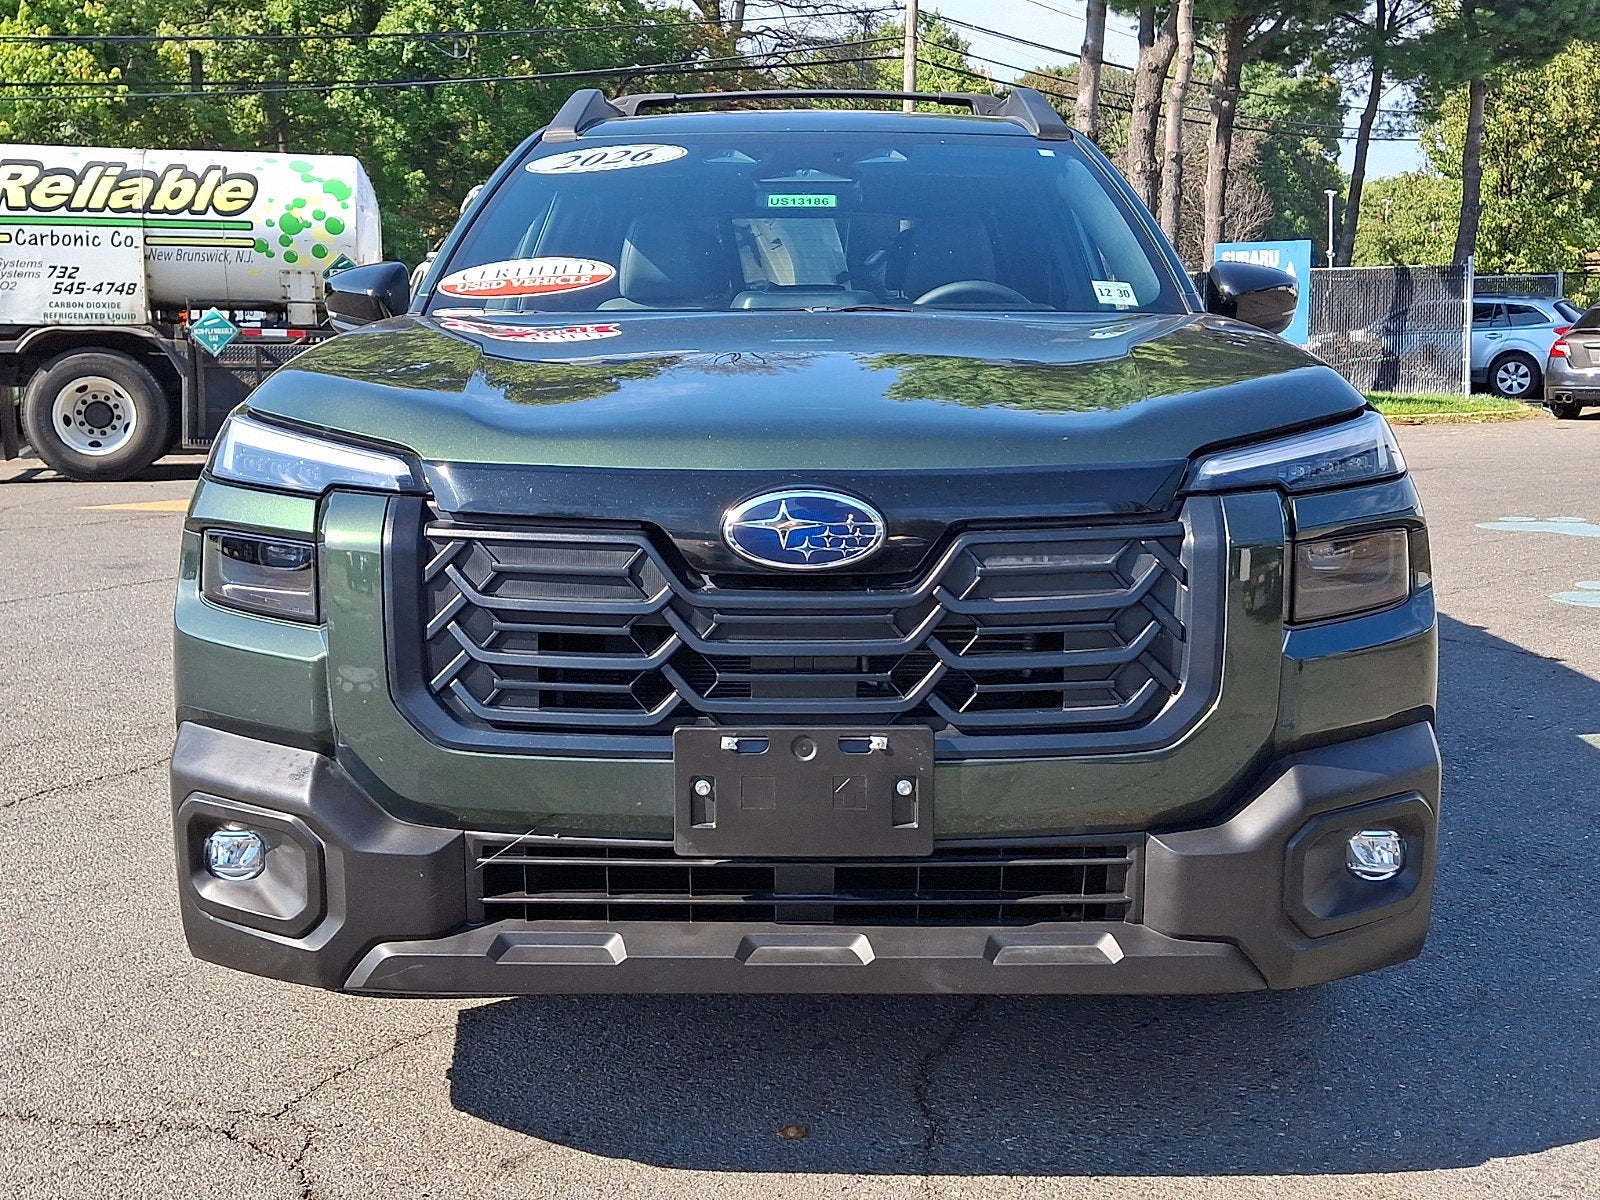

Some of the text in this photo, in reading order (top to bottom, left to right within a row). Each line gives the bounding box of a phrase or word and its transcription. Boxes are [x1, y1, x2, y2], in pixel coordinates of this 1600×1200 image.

[550, 147, 662, 170] 2026
[0, 159, 258, 216] Reliable
[770, 197, 829, 206] US13186
[15, 228, 140, 249] Carbonic Co.
[149, 248, 254, 265] New Brunswick, N.J.
[1221, 249, 1280, 268] SUBARU
[0, 267, 41, 279] ystems
[47, 265, 80, 279] 732
[0, 280, 17, 291] O2
[52, 281, 138, 295] 545-4748
[455, 275, 593, 292] USED VEHICLE
[1098, 287, 1130, 298] 12 30
[48, 301, 121, 310] CARBON DIOXIDE
[43, 311, 136, 320] REFRIGERATED LIQUID
[208, 334, 219, 342] GAS
[212, 343, 218, 351] 2
